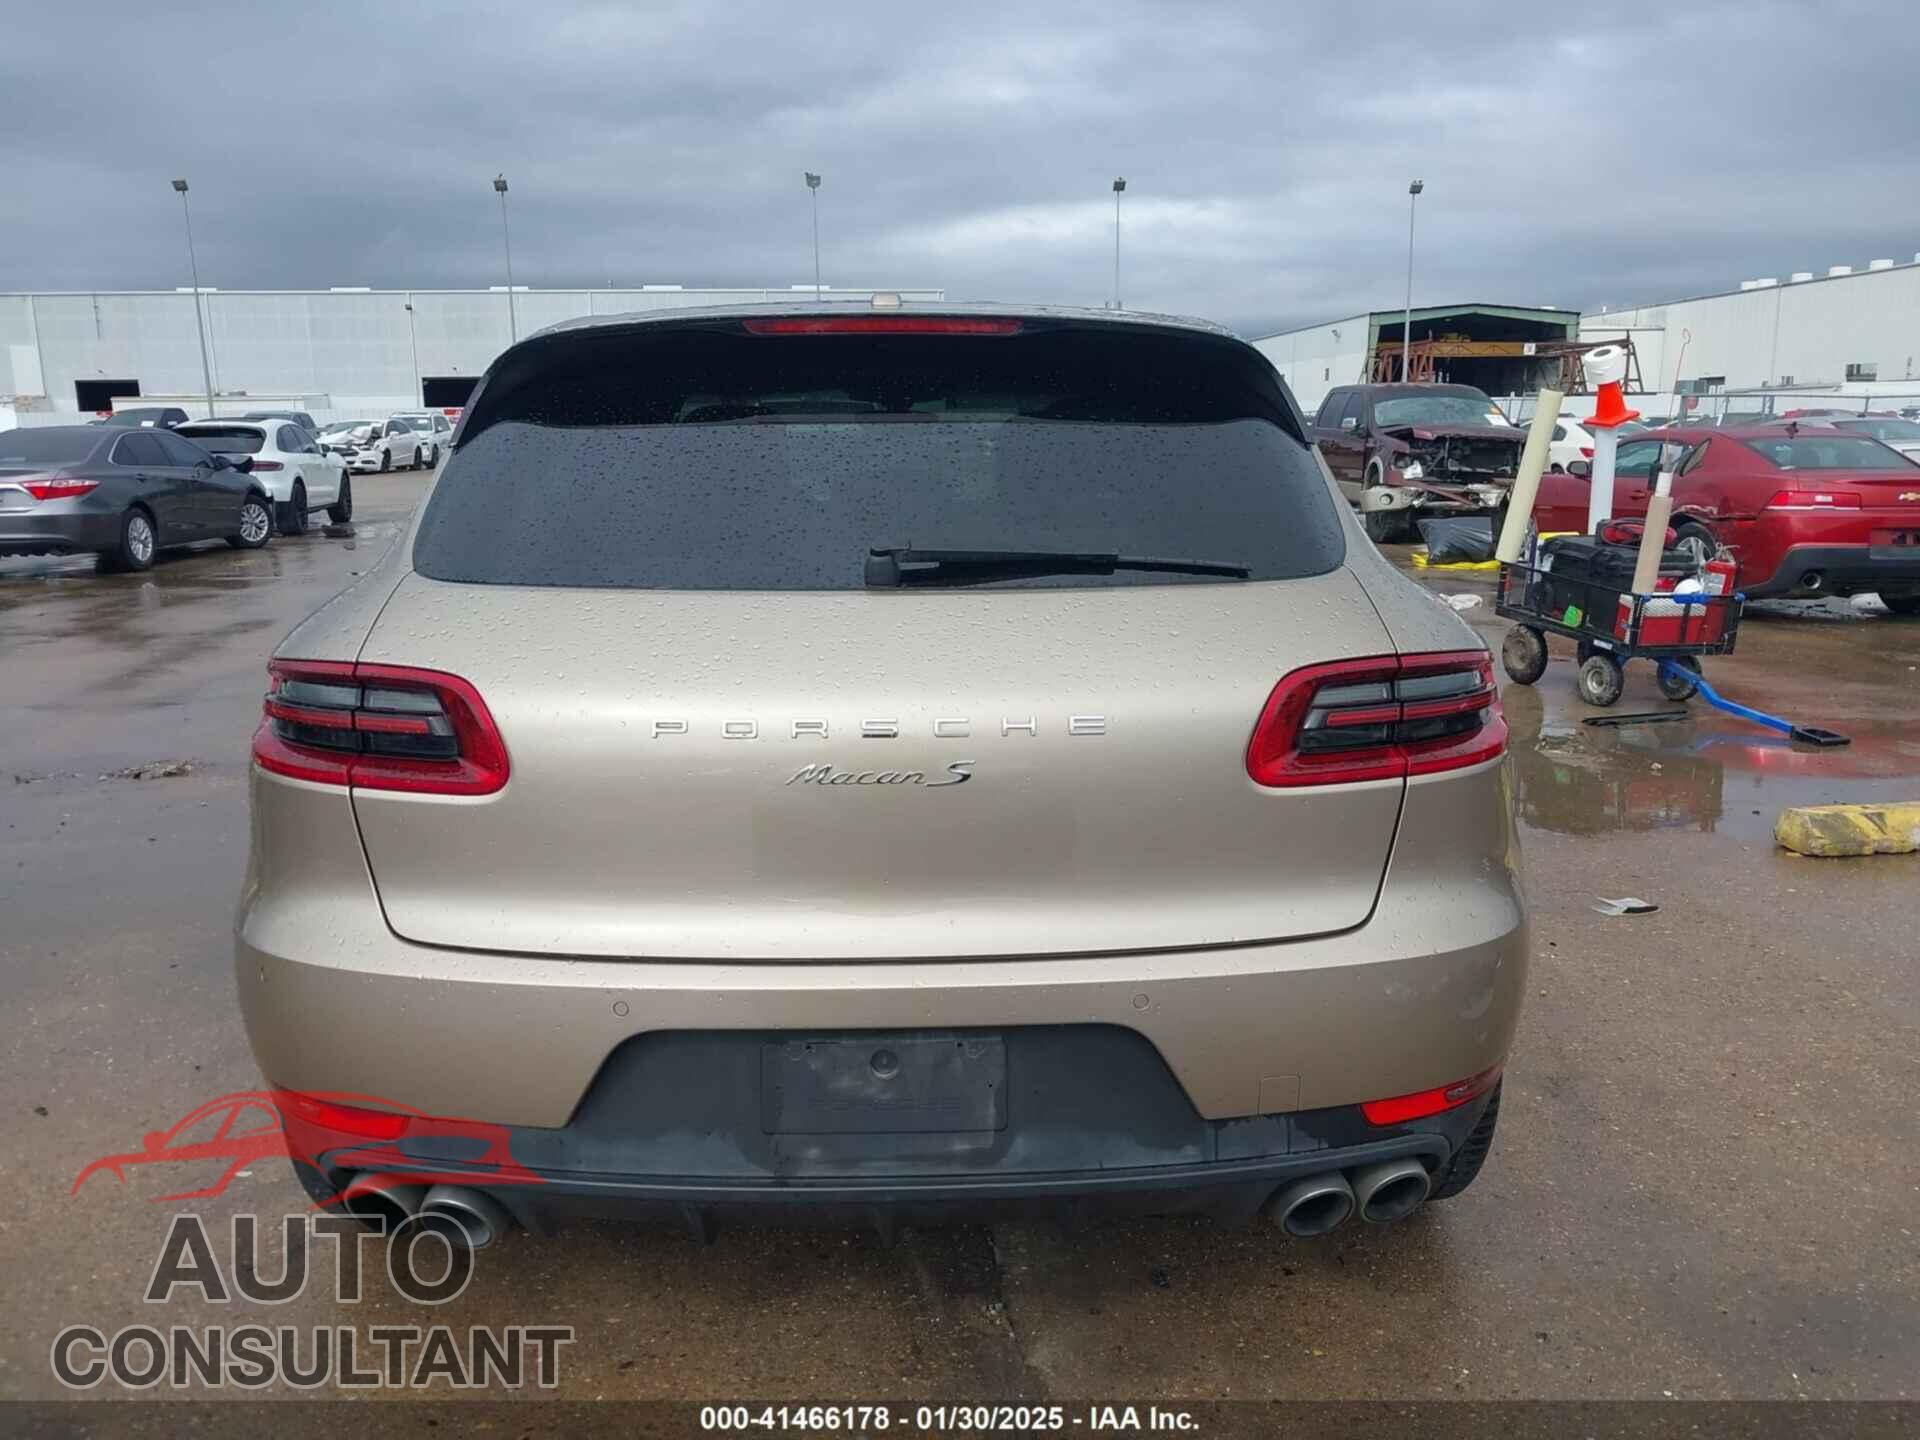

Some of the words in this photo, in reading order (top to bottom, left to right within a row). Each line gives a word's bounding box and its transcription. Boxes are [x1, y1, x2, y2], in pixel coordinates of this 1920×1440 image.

[651, 715, 1106, 739] PORSCHE
[786, 762, 927, 787] Macan
[924, 759, 976, 787] S
